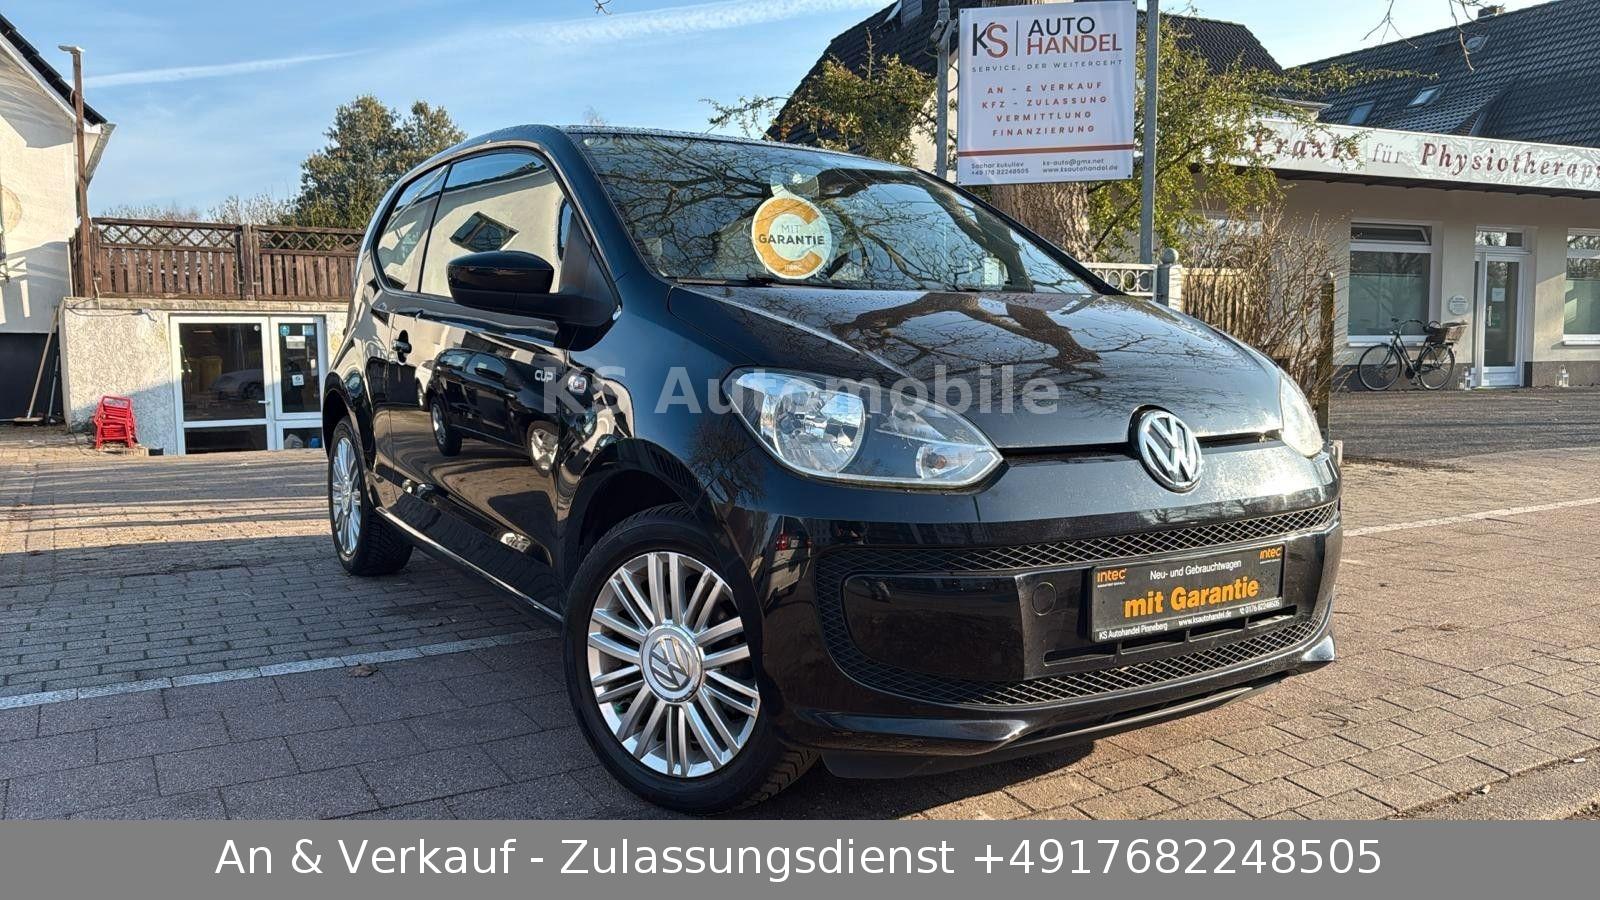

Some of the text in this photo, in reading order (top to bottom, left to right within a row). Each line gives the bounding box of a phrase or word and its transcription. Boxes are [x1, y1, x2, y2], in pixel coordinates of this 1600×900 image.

[1028, 16, 1095, 37] AUTO
[972, 21, 1008, 58] KS
[1026, 33, 1122, 55] HANDEL
[1027, 62, 1047, 70] DER
[987, 86, 1004, 94] AN
[1040, 81, 1103, 92] VERKAUF
[982, 101, 1006, 109] KFZ
[1027, 96, 1108, 107] ZULASSUNG
[996, 111, 1092, 122] VERMITTLUNG
[992, 125, 1095, 137] FINANZIERUNG
[1372, 142, 1403, 164] für
[781, 224, 800, 234] MIT
[1097, 568, 1127, 583] intec
[1150, 559, 1242, 581] Neu- und Gebrauchtwagen
[1124, 576, 1260, 618] mit Garantie
[1099, 630, 1108, 640] KS
[1108, 625, 1141, 639] Autohandel
